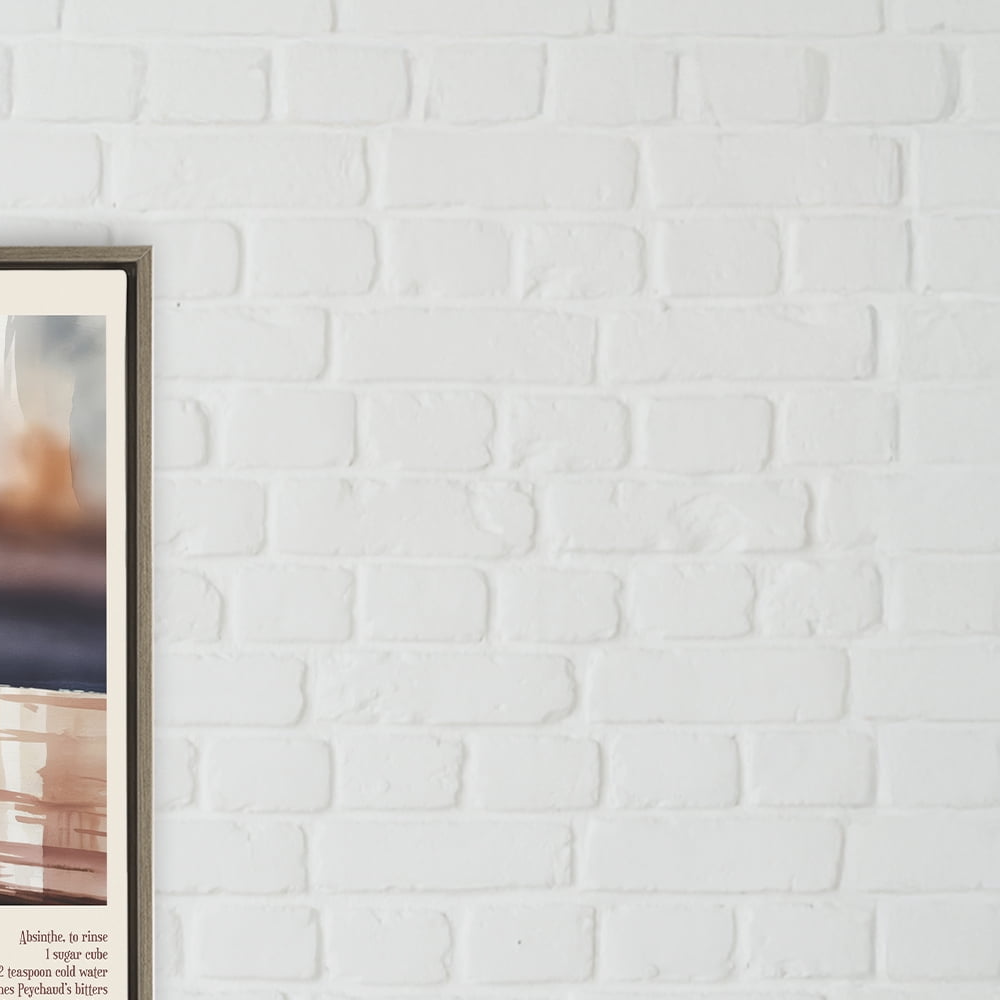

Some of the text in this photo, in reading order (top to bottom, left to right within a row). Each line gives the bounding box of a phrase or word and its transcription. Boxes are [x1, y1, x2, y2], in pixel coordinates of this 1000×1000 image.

[19, 929, 109, 945] Absinthe, to rinse
[45, 946, 109, 964] 1 sugar cube
[7, 966, 53, 981] teaspoon
[54, 964, 76, 978] cold
[78, 966, 109, 980] water
[17, 981, 72, 999] Peychaud's
[74, 982, 109, 997] bitters
